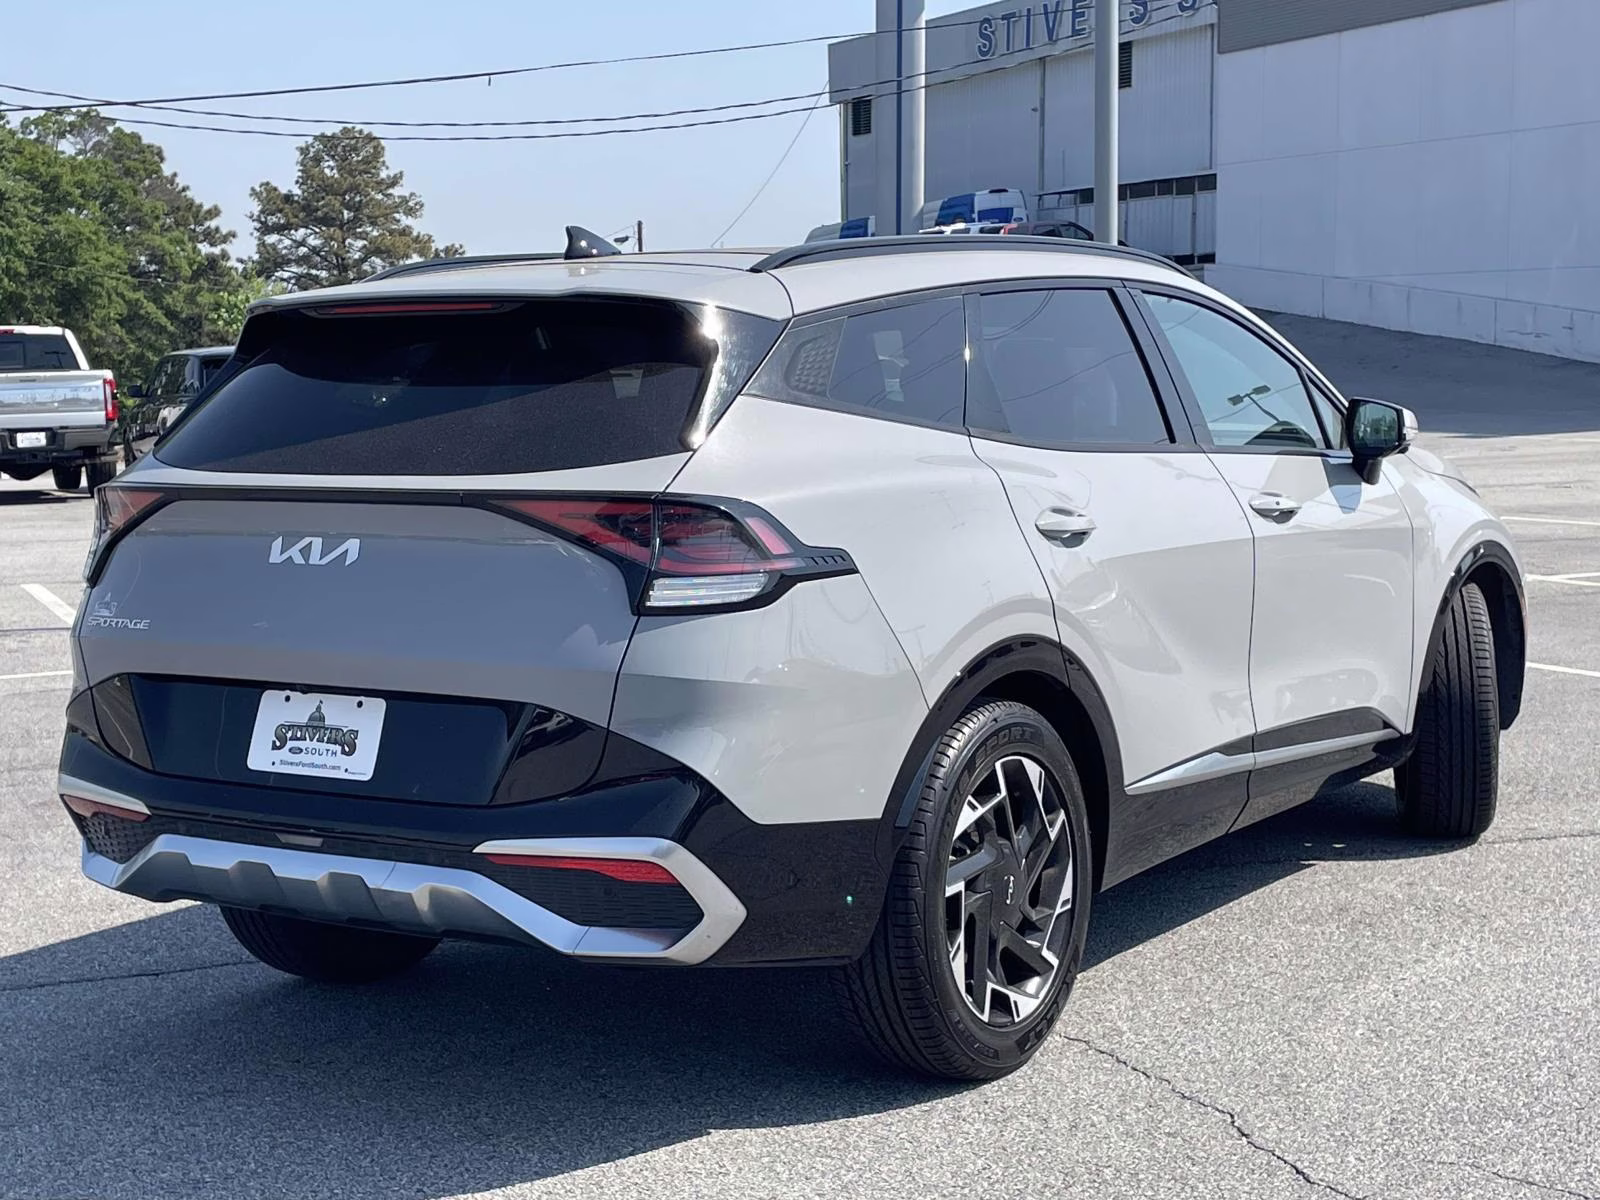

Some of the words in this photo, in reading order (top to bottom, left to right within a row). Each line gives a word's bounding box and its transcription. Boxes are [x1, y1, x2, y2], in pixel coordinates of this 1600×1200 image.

[976, 0, 1150, 59] STIVES
[269, 536, 360, 566] KIA
[87, 617, 150, 629] SPORTAGE
[271, 723, 358, 756] STIVERS
[304, 747, 337, 757] SOUTH
